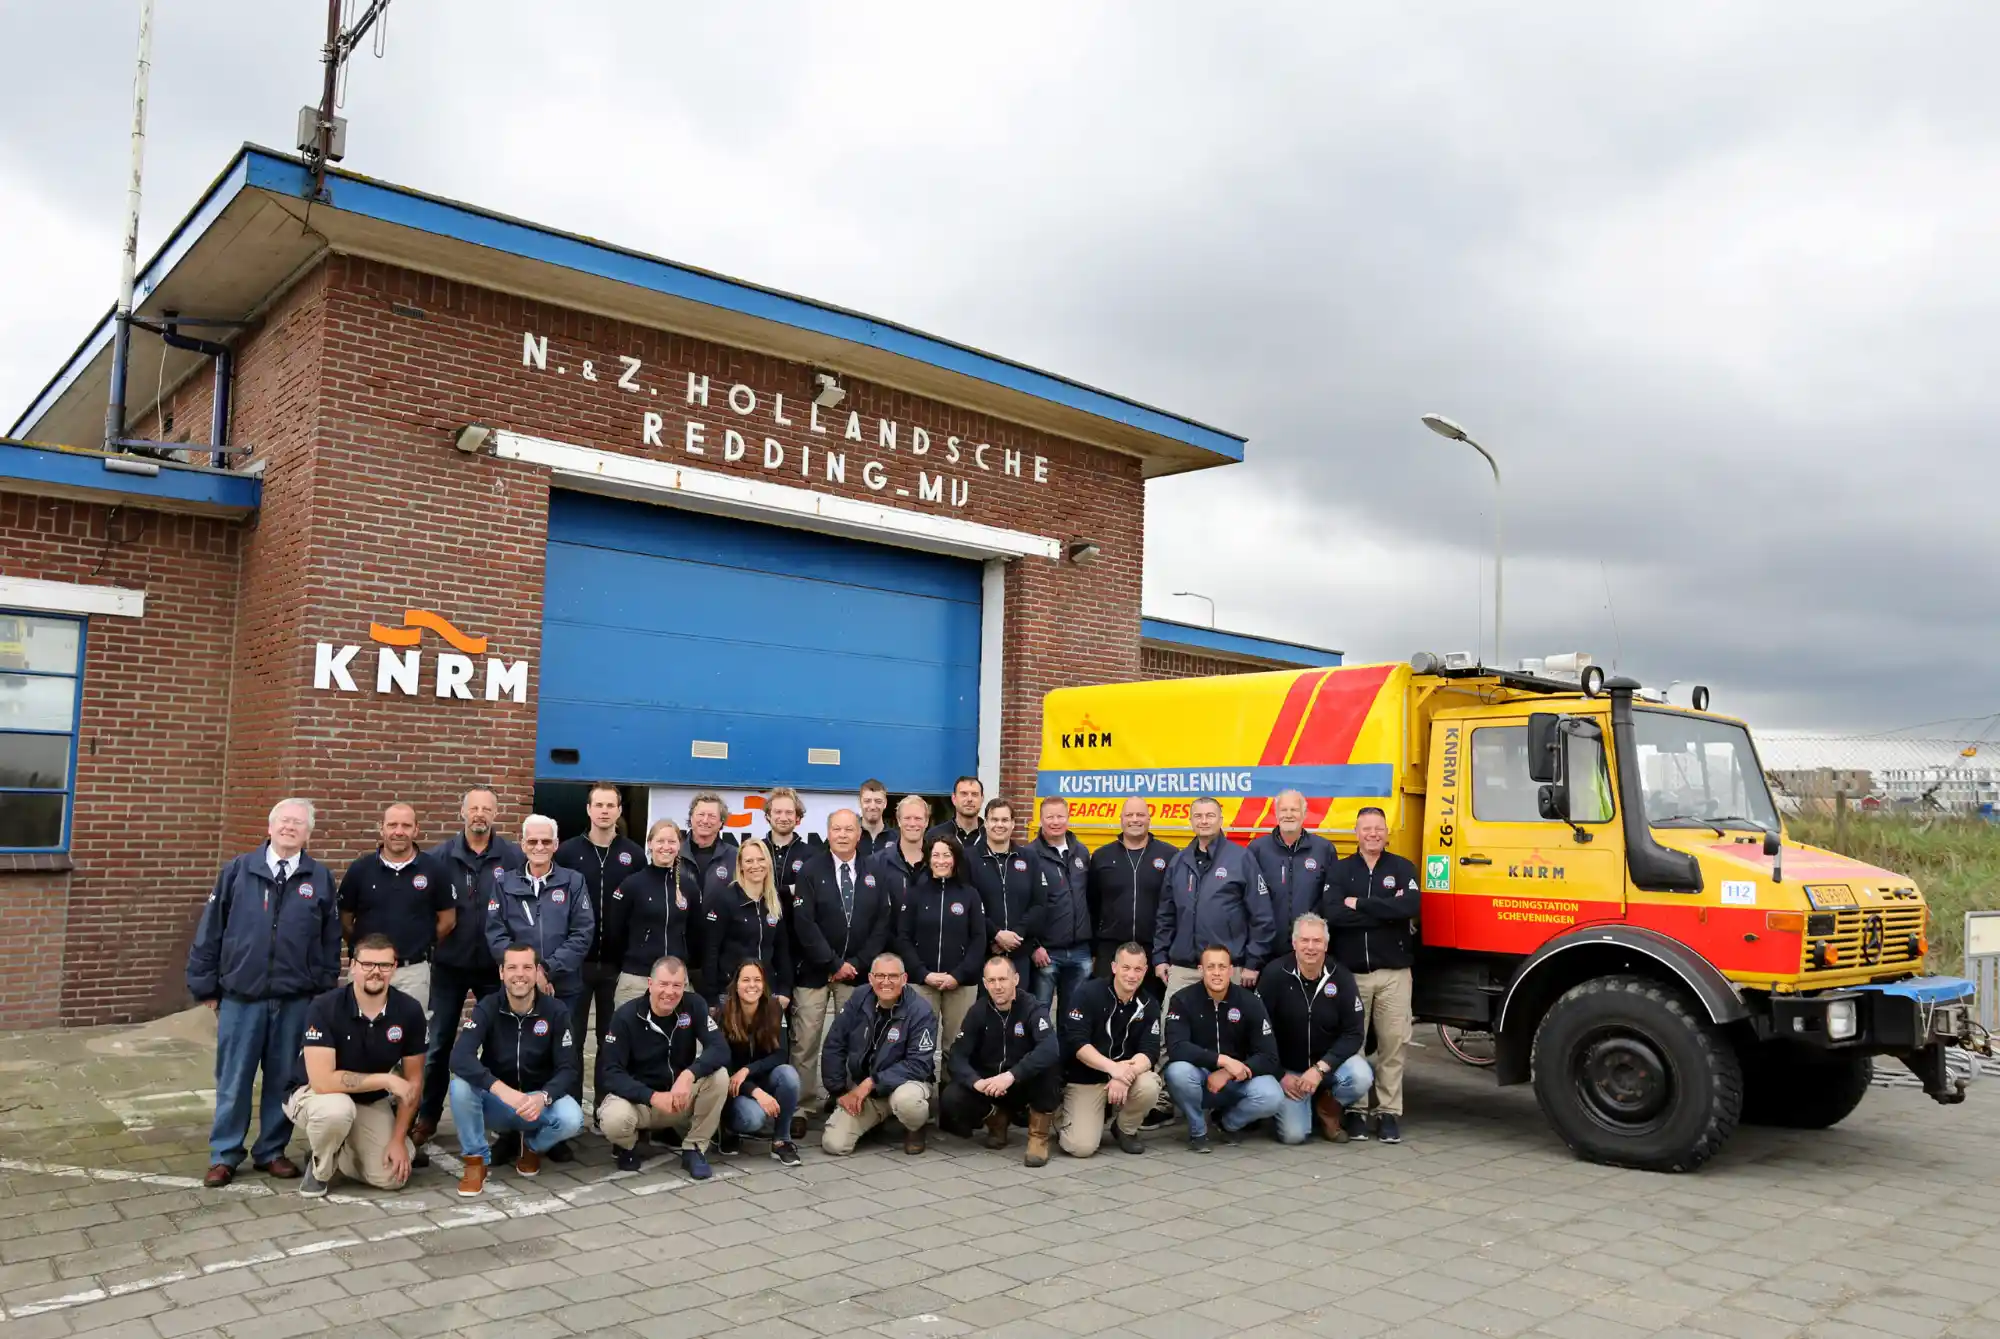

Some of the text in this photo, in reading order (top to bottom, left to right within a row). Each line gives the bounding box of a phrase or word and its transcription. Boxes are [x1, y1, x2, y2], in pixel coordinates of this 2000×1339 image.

[582, 360, 598, 382] &
[686, 372, 1048, 484] HOLLANDSCHE
[313, 642, 529, 704] KNRM
[1061, 732, 1112, 749] KNRM
[1059, 772, 1252, 794] KUSTHULPVERLENING
[1440, 727, 1459, 848] KNRM 71-92
[1068, 802, 1117, 818] EARCH
[1508, 865, 1565, 880] KNRM
[1427, 879, 1449, 889] AED
[1492, 898, 1579, 912] REDDINGSTATION
[1497, 911, 1575, 925] SCHEVENINGEN
